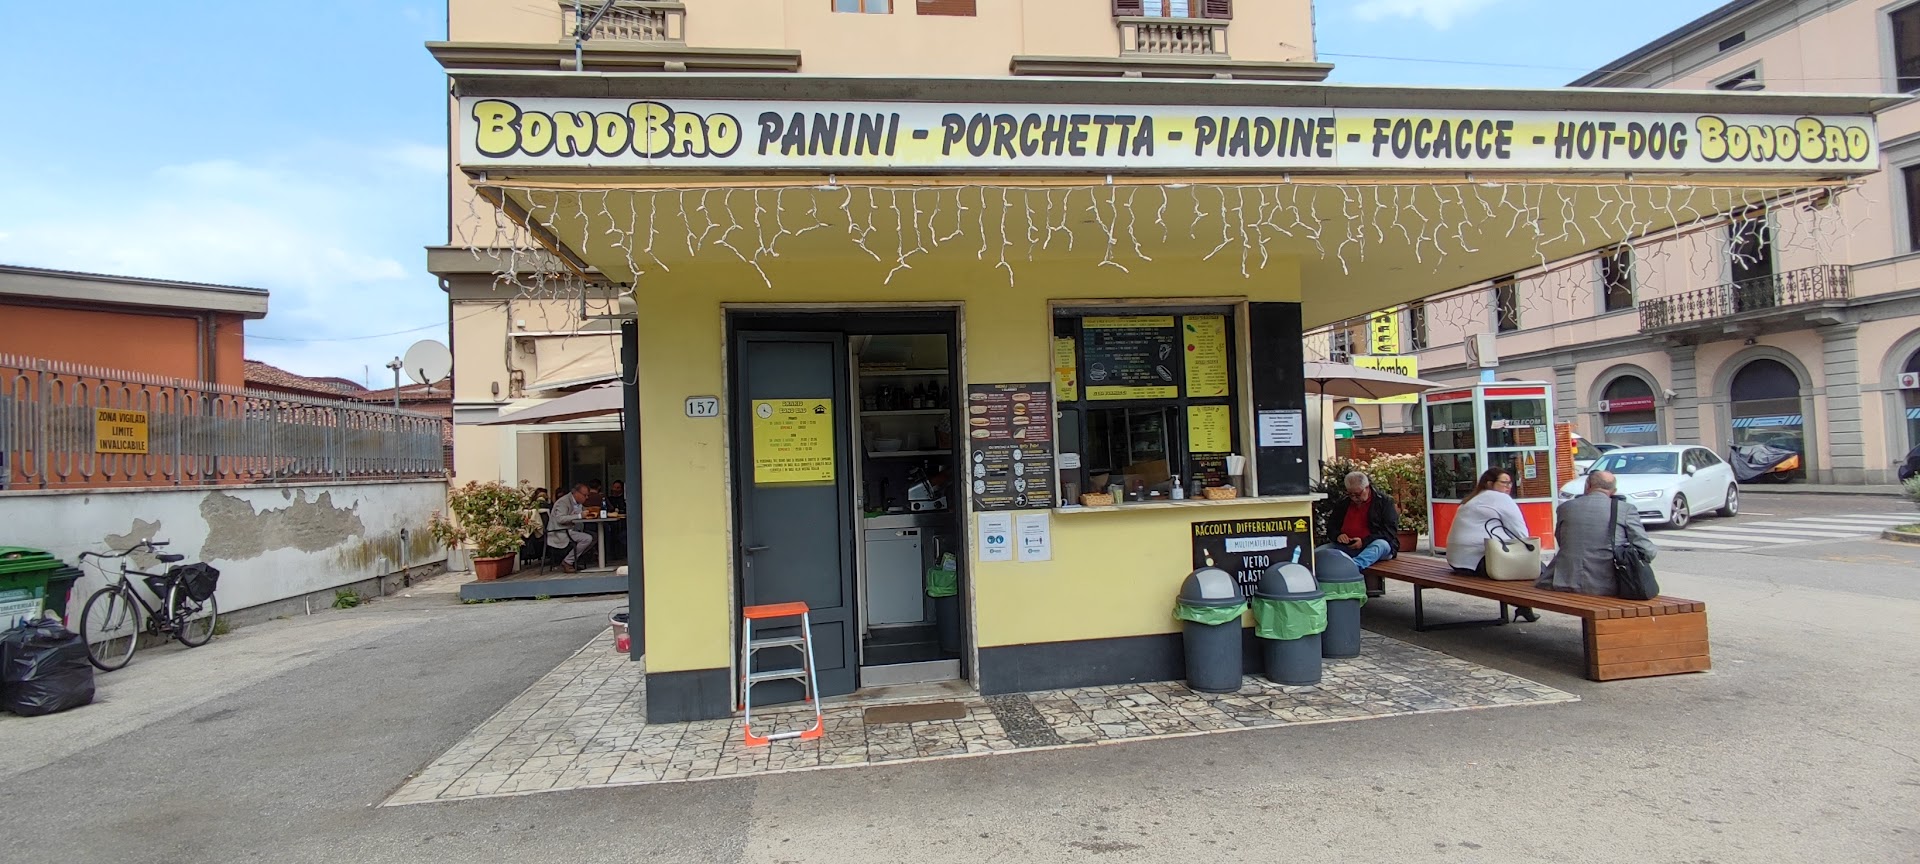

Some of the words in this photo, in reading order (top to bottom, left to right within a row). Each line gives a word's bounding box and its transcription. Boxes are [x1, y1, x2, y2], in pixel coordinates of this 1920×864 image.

[757, 111, 900, 156] PANINI
[941, 112, 1154, 159] PORCHETTA
[1194, 116, 1334, 158] PIADINE
[1372, 118, 1514, 160] FOCACCE
[1554, 120, 1688, 160] HOT-DOG
[689, 401, 715, 414] 157
[98, 411, 117, 422] ZONA
[119, 413, 146, 424] VIGILATA
[1509, 418, 1541, 426] TELECOM
[112, 426, 134, 437] LIMITE
[99, 439, 146, 451] INVALICABILE
[1195, 523, 1233, 537] RACCOLTA
[1236, 520, 1293, 534] DIFFERENZIATA
[1234, 539, 1278, 549] MULTIMATERIALE
[1243, 555, 1270, 569] VETRO
[1238, 569, 1265, 583] PLAST
[1240, 584, 1259, 597] LLU
